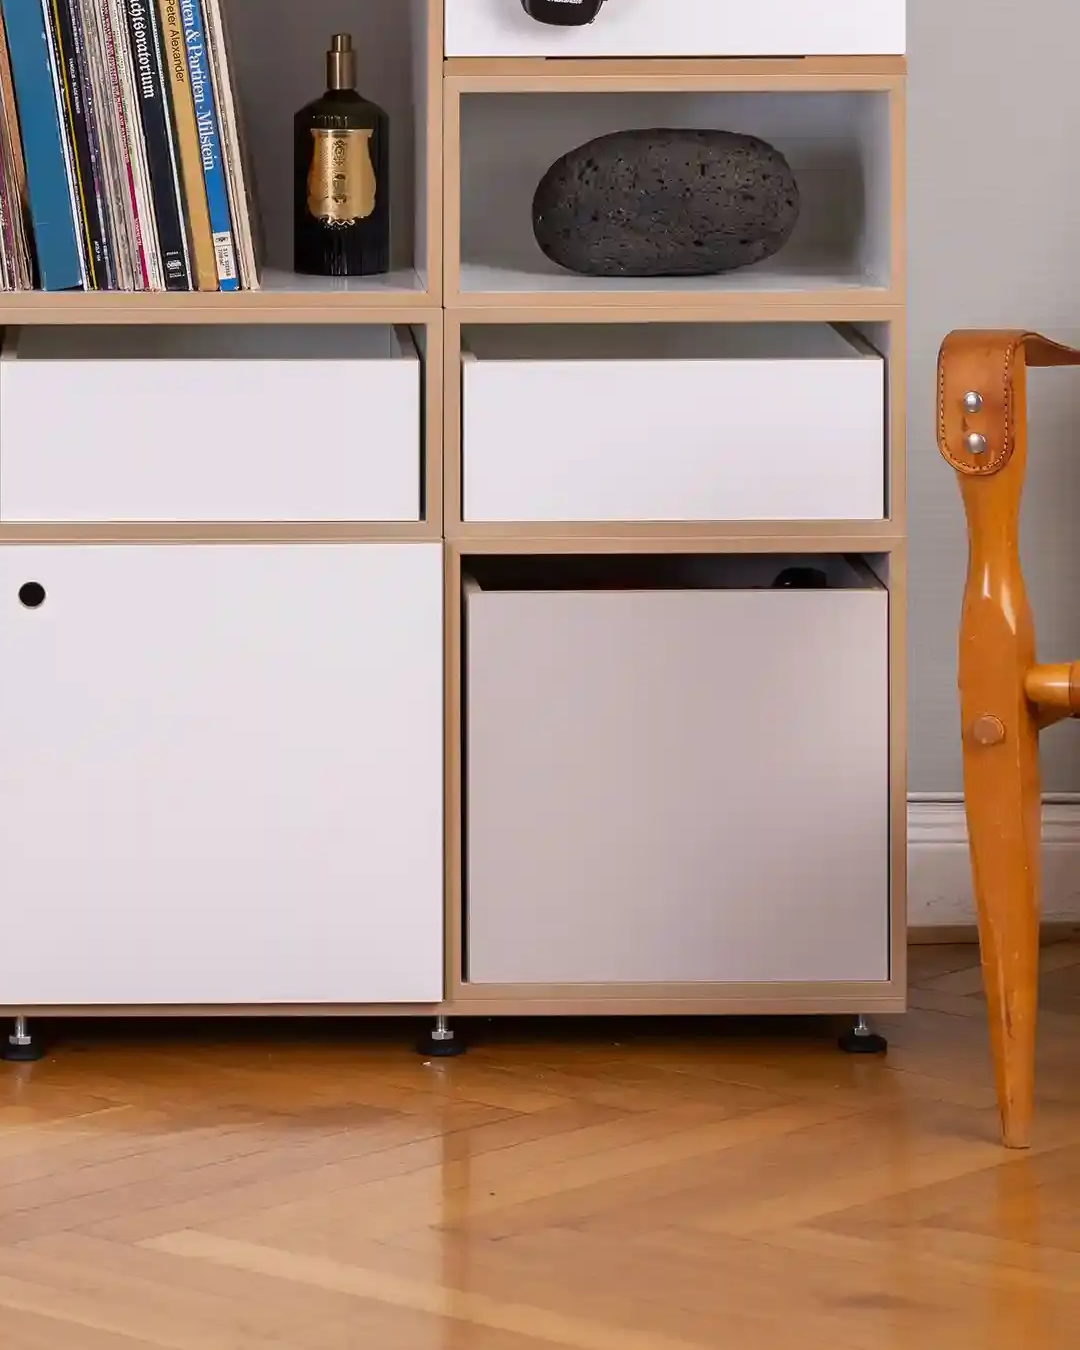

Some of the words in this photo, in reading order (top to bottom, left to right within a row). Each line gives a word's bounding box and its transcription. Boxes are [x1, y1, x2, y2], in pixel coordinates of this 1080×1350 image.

[169, 29, 186, 83] Alexander
[185, 28, 201, 43] &
[187, 43, 209, 103] Partiten
[196, 110, 219, 171] Milstein
